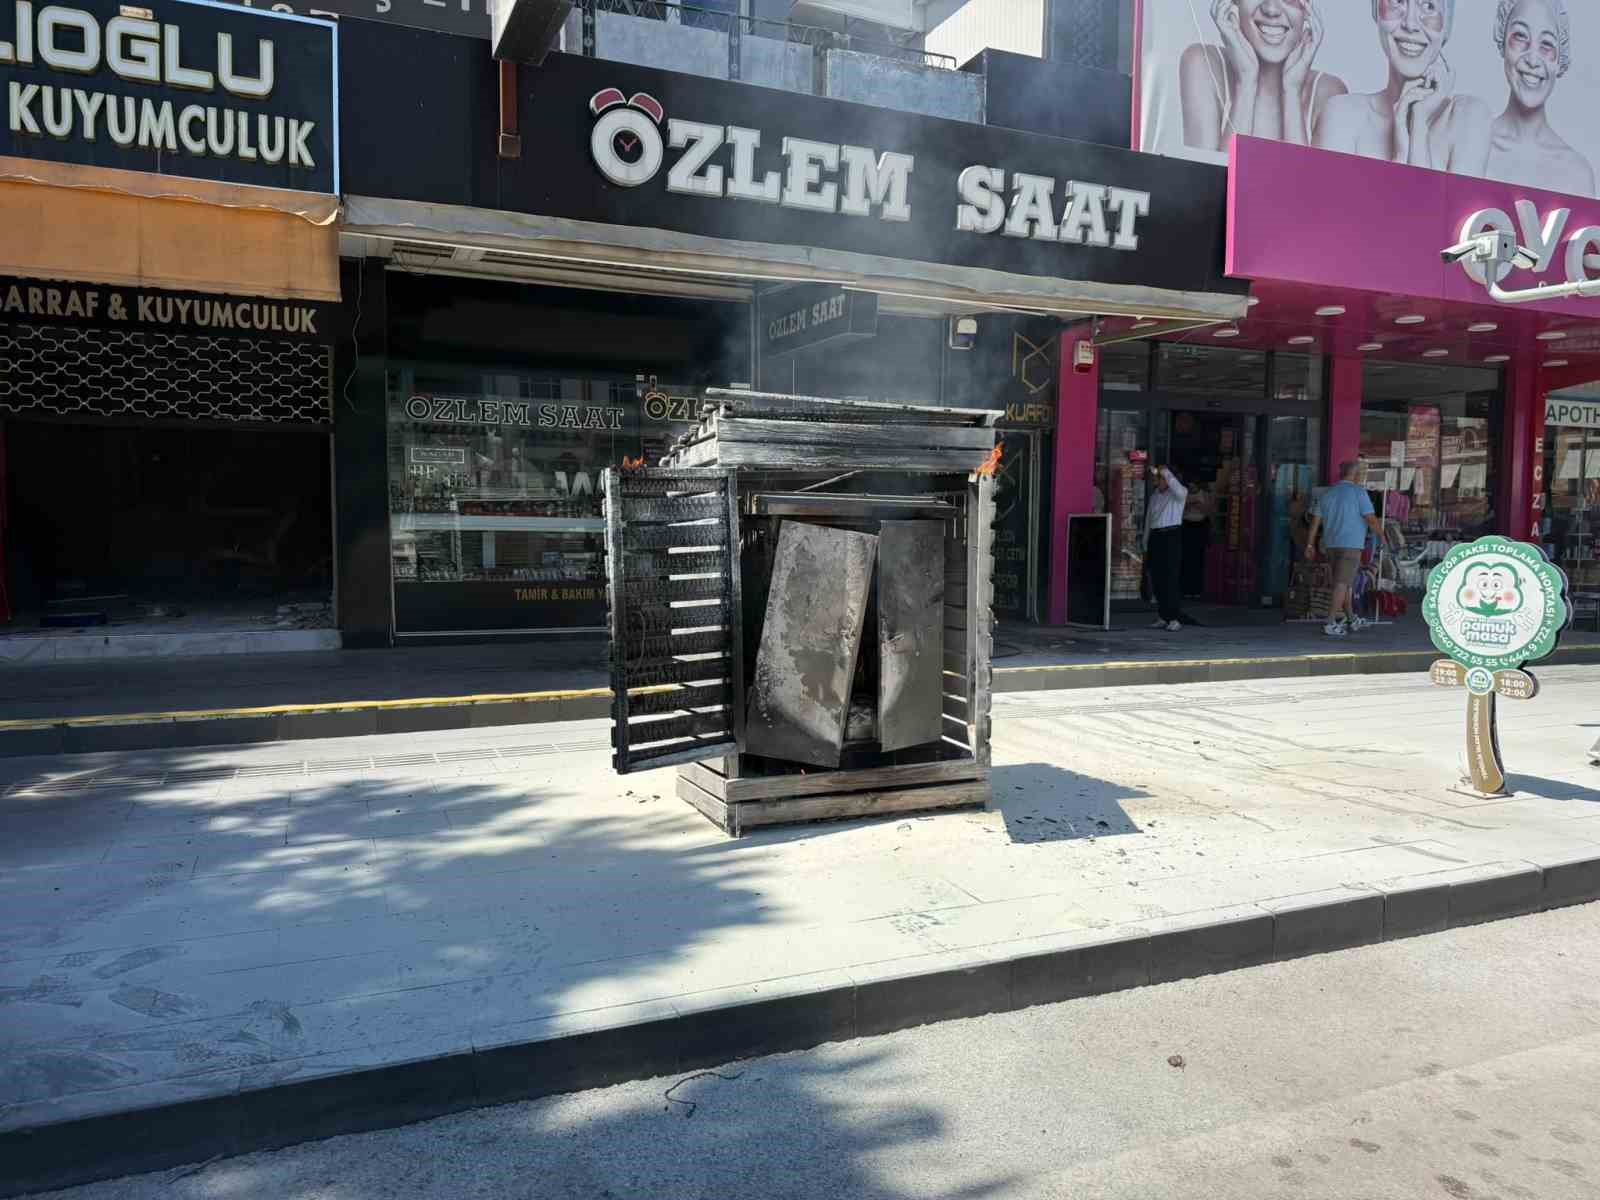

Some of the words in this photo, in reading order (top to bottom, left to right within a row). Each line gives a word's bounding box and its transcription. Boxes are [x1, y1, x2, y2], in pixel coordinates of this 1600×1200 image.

[0, 0, 274, 97] IOĞLU
[9, 81, 316, 168] KUYUMCULUK
[590, 87, 915, 222] ÖZLEM
[956, 164, 1151, 251] SAAT
[0, 284, 99, 317] ARRAF
[108, 293, 129, 321] &
[137, 295, 318, 334] KUYUMCULUK
[812, 294, 846, 326] SAAT
[538, 403, 625, 430] SAAT
[1458, 543, 1489, 561] TAKSİ
[1492, 543, 1541, 572] TOPLAMA
[1461, 620, 1516, 635] pamuk
[1465, 631, 1509, 643] masa
